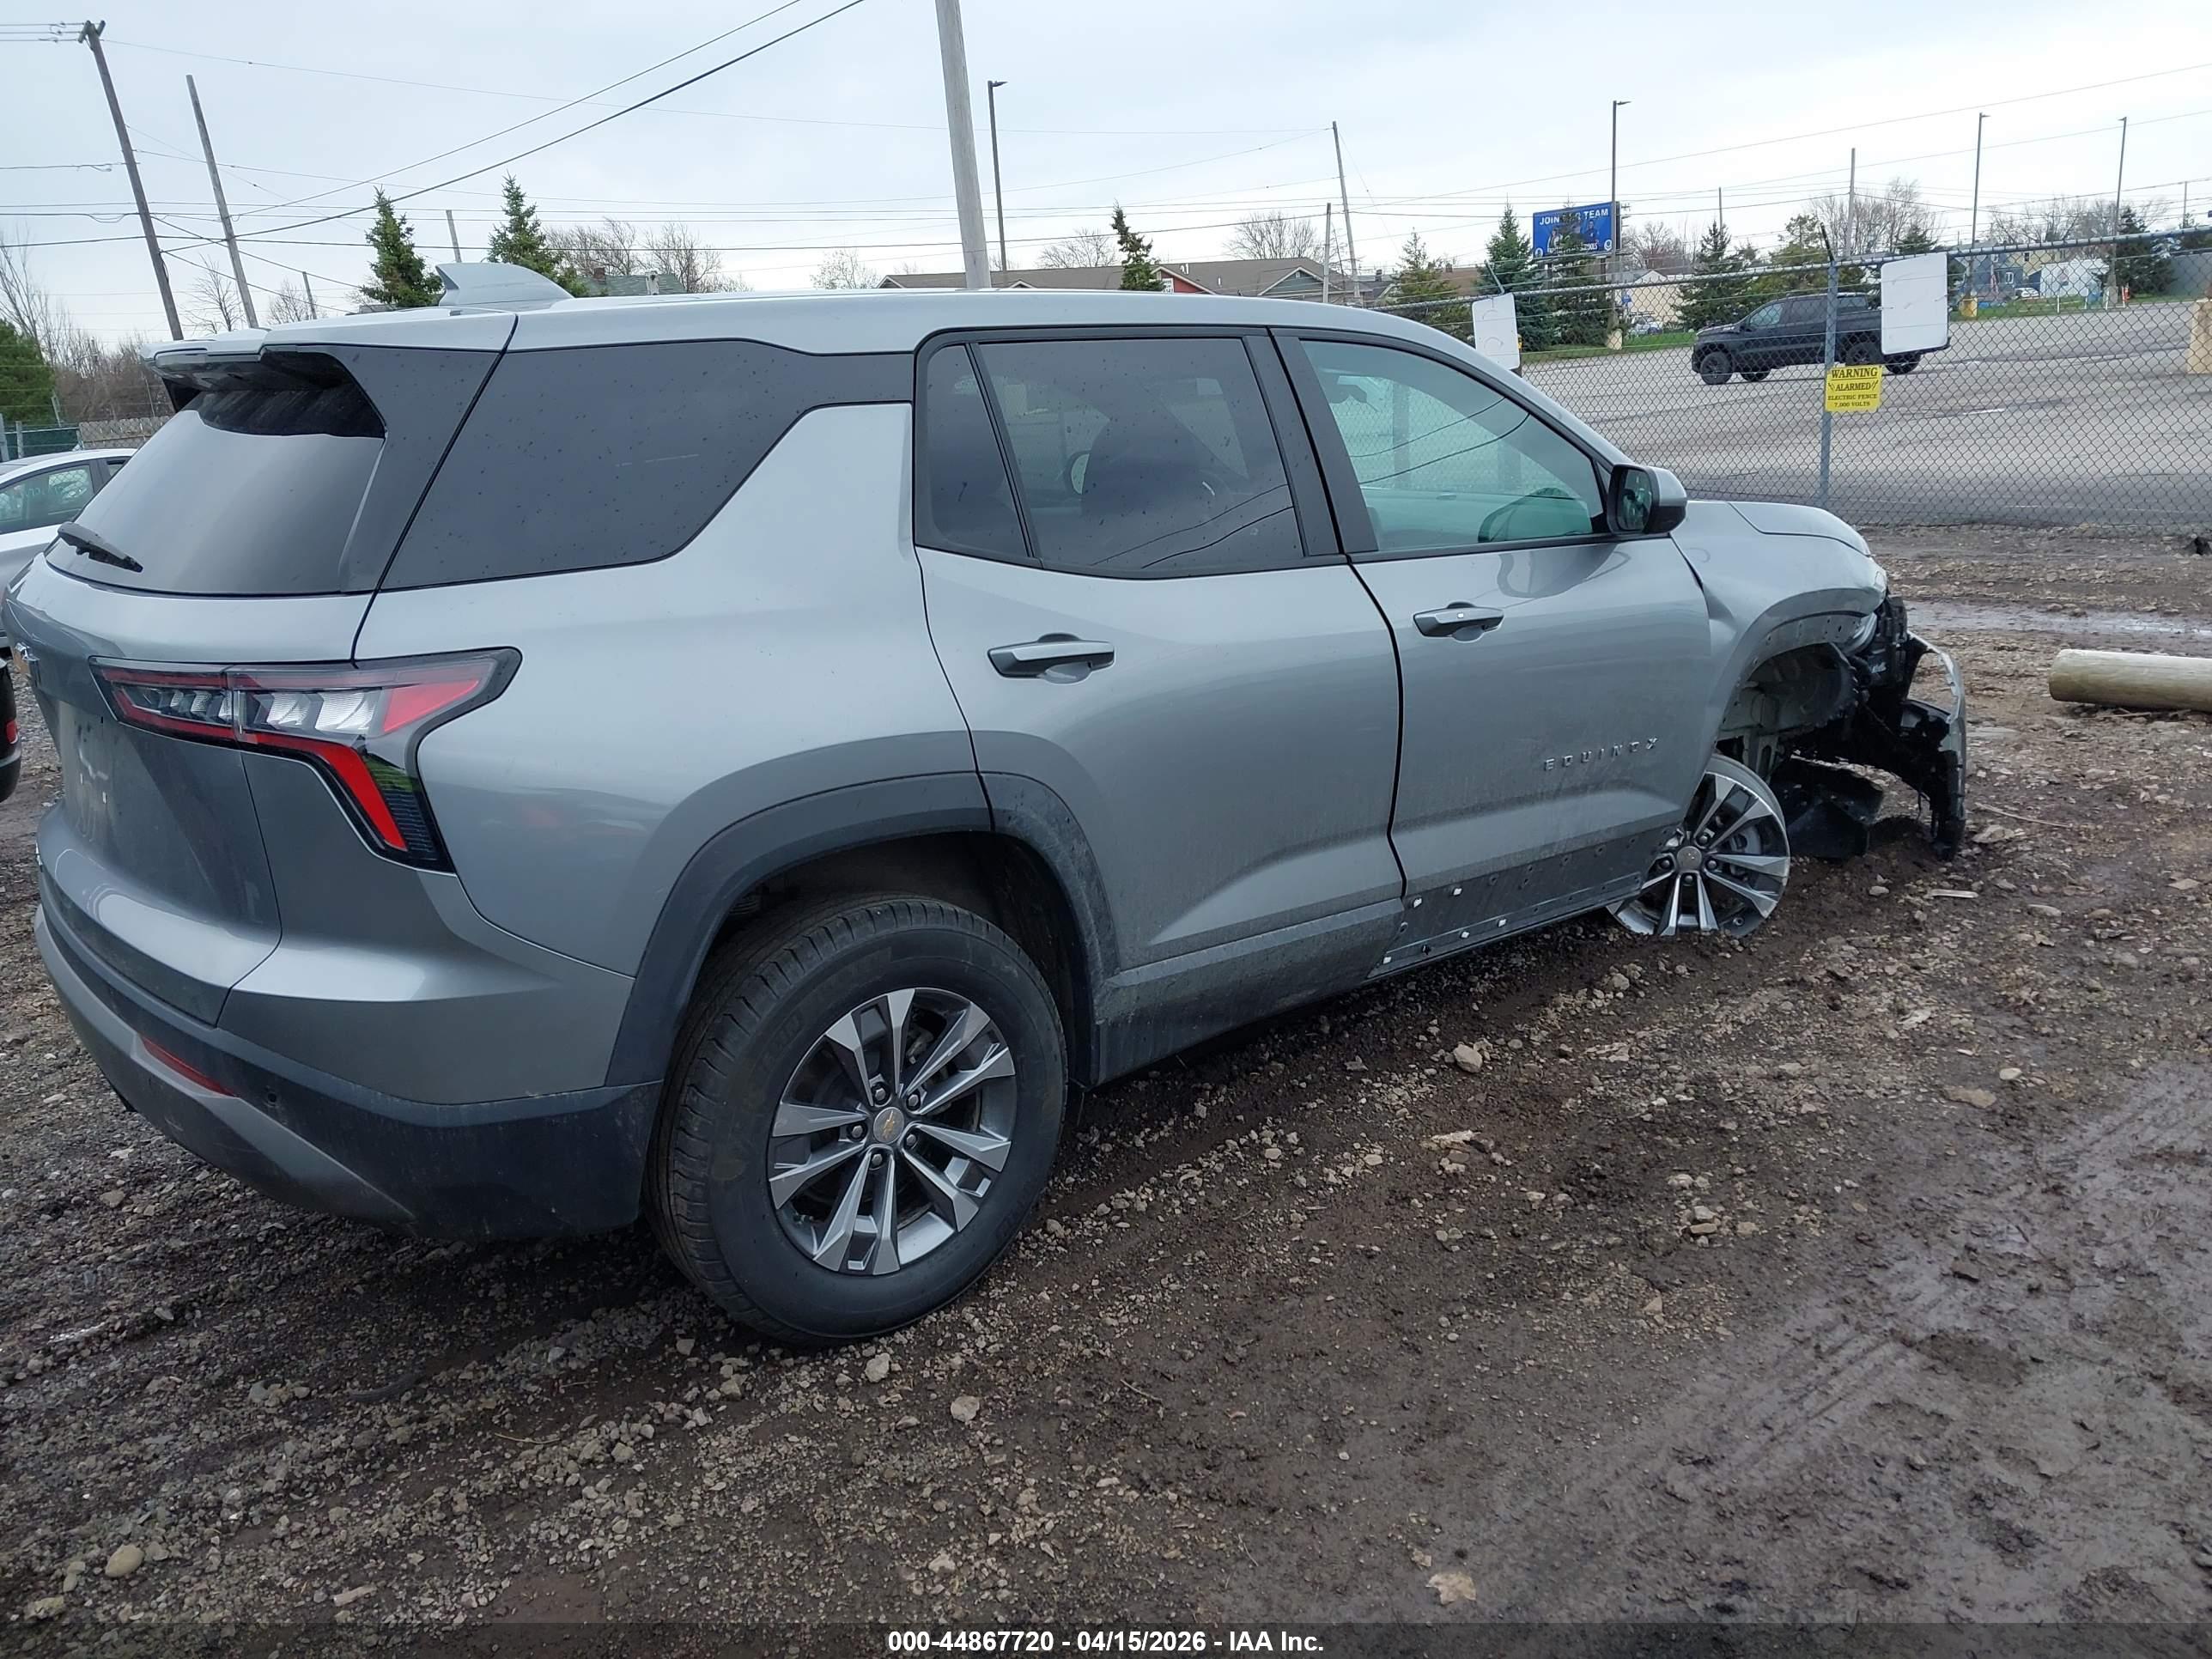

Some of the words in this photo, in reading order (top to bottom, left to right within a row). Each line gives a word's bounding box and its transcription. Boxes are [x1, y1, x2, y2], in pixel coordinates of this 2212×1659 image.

[1539, 216, 1560, 226] JOIN
[1583, 208, 1608, 219] TEAM
[1832, 368, 1878, 379] WARNING
[1835, 382, 1871, 392] ALARMED
[1544, 736, 1658, 771] EQUINOX
